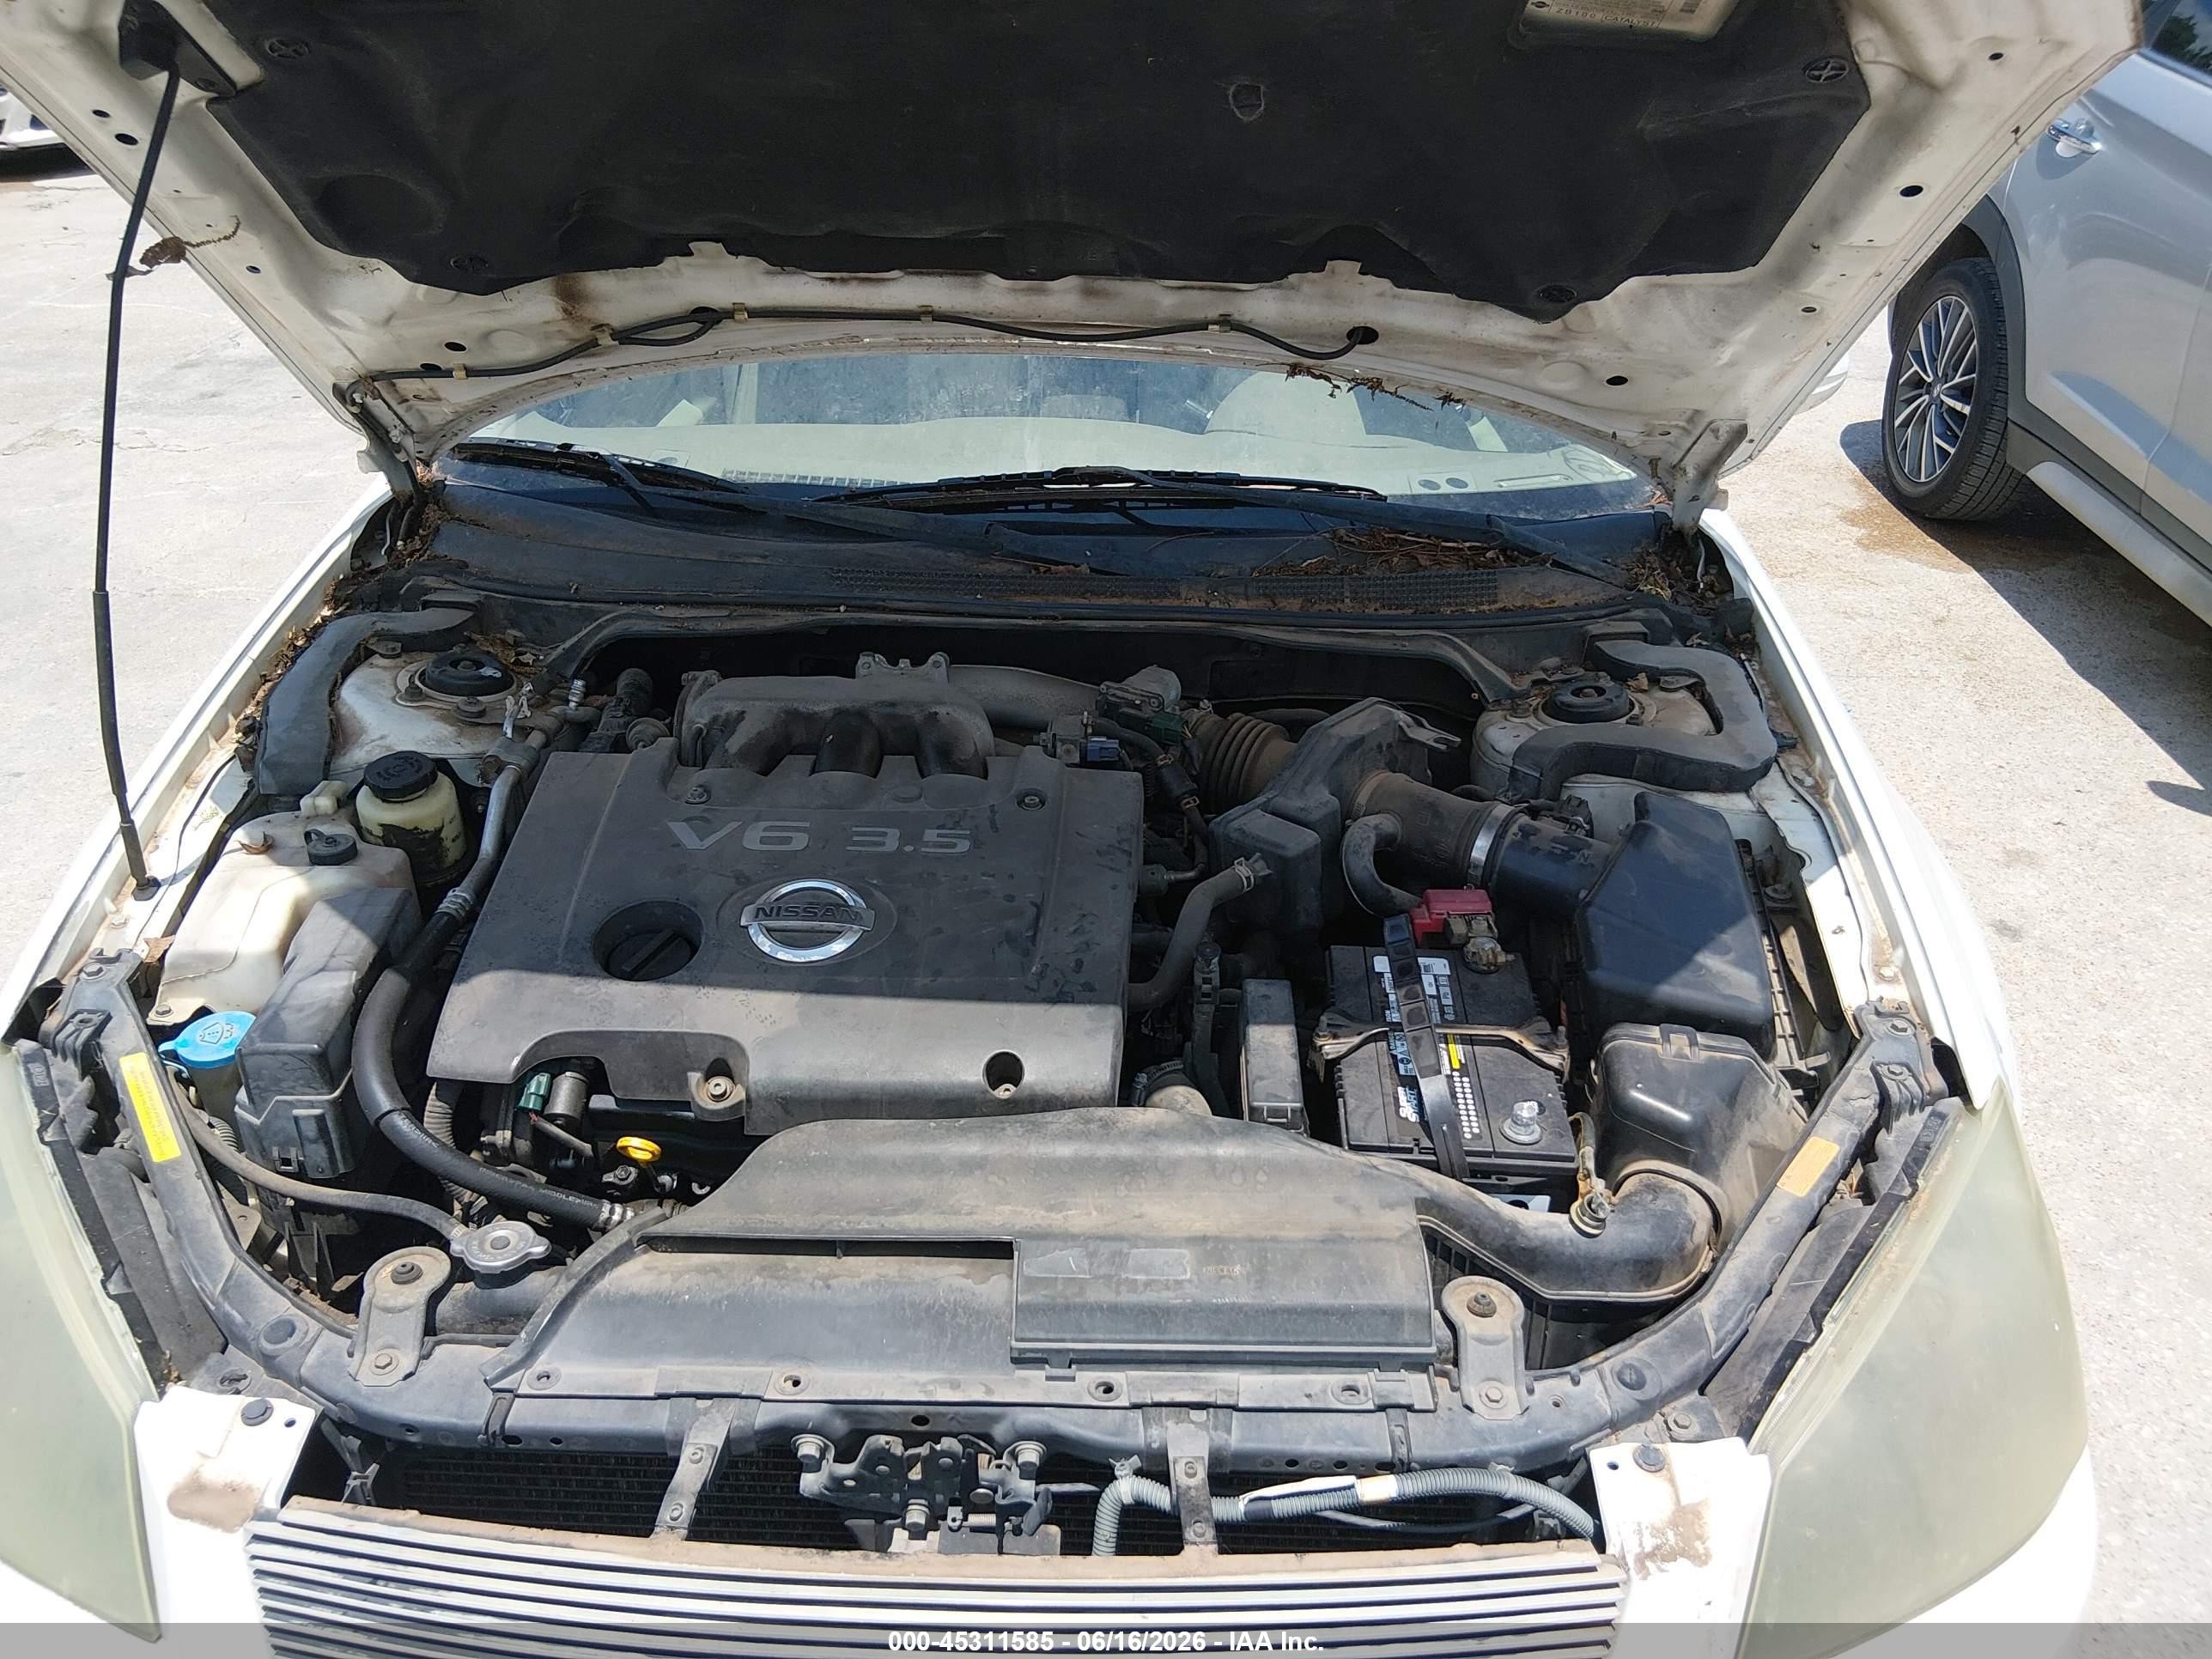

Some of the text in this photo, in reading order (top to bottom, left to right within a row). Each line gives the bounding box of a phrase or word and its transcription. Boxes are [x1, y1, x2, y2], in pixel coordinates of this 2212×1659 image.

[1603, 15, 1658, 28] CATALYST
[667, 821, 971, 854] V6 3.5
[755, 904, 865, 922] NISSAN
[1405, 1085, 1420, 1123] START
